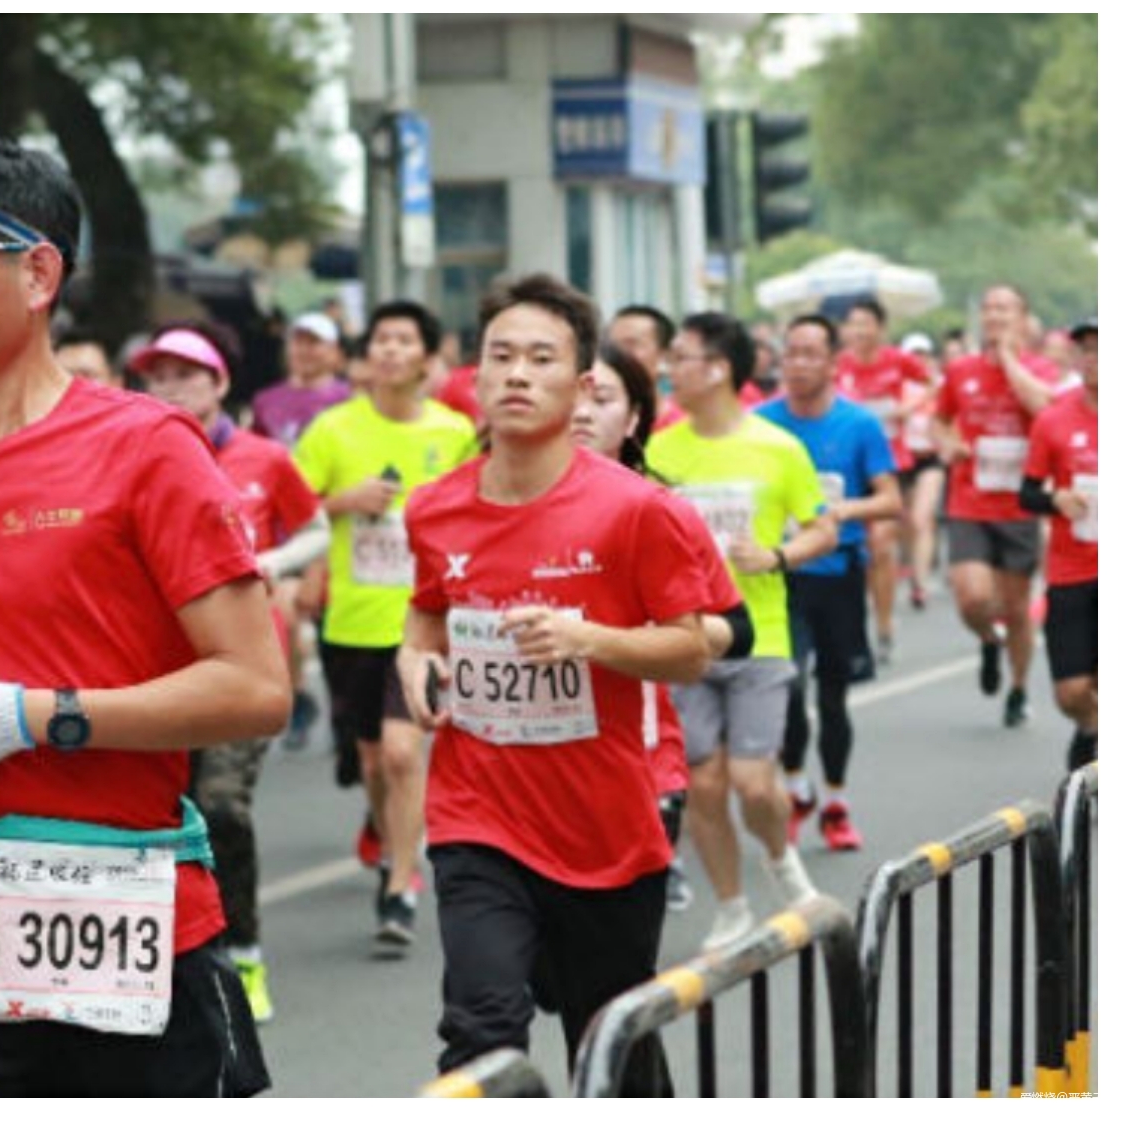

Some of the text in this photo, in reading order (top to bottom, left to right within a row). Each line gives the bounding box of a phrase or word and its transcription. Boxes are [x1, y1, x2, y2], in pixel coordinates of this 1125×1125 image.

[455, 658, 581, 702] C 52710
[17, 910, 160, 973] 30913
